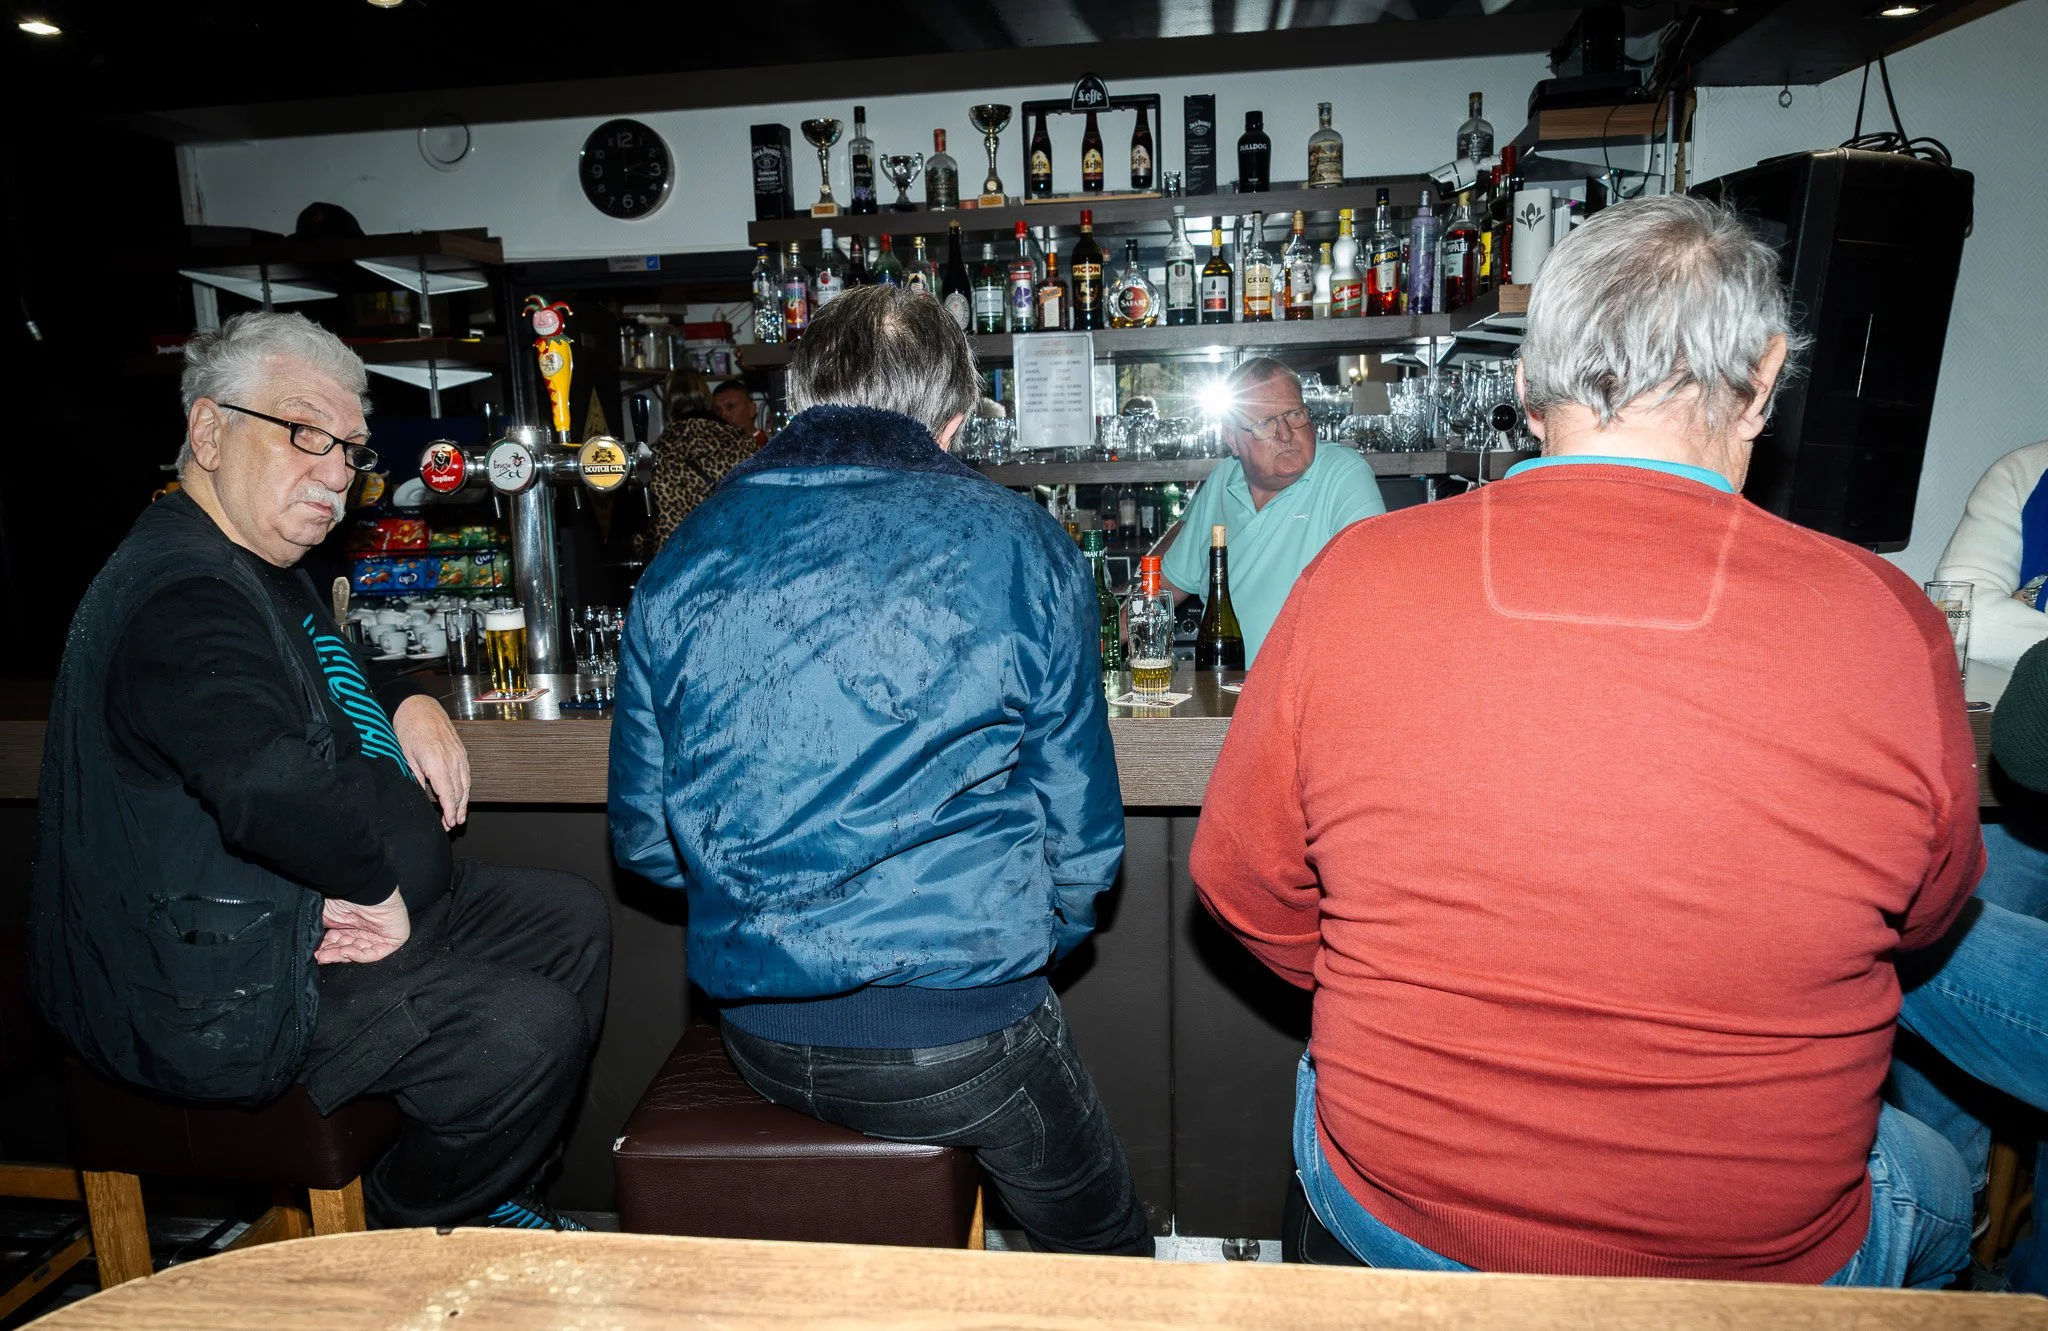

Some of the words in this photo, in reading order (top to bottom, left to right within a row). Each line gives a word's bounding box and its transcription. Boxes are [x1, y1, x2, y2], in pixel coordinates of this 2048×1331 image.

[1077, 88, 1103, 105] Leffe
[617, 132, 633, 148] 12
[1239, 143, 1267, 152] BULLDOG
[648, 162, 661, 177] 3
[1085, 159, 1101, 170] Leffe
[592, 164, 603, 178] 9
[622, 193, 634, 209] 6
[1073, 266, 1099, 274] PICON
[584, 465, 610, 473] SCOTCH
[431, 474, 456, 483] Jupiler
